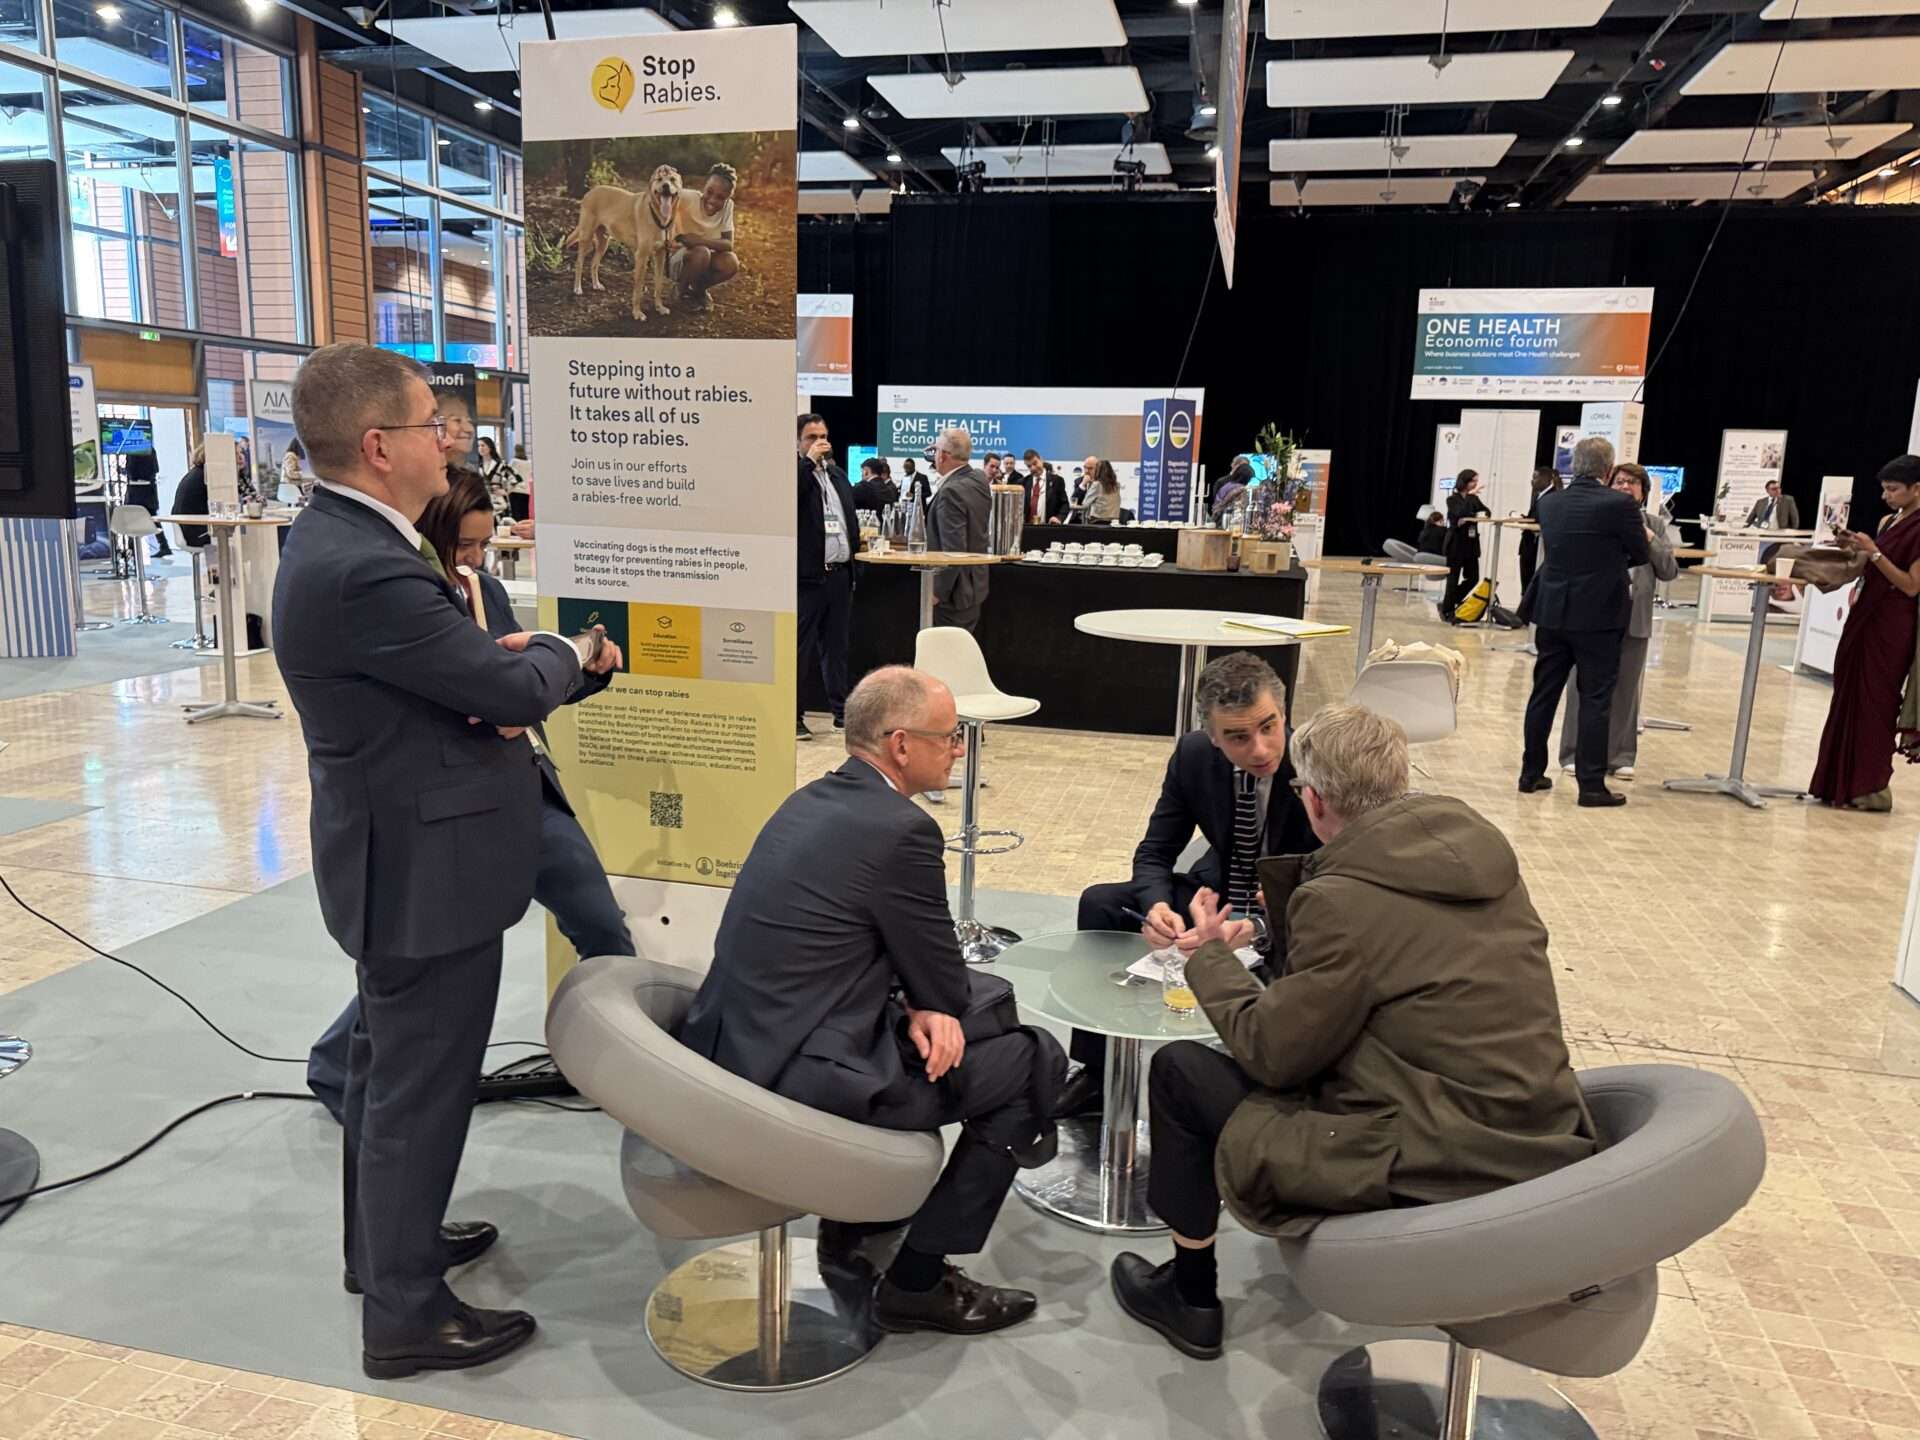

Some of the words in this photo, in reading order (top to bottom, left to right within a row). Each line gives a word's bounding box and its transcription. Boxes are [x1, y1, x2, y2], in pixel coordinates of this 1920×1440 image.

[642, 55, 695, 79] Stop
[644, 81, 720, 104] Rabies.
[1427, 319, 1471, 335] ONE
[1478, 319, 1561, 335] HEALTH
[1425, 334, 1504, 348] Economic
[1509, 334, 1558, 348] forum
[569, 360, 645, 381] Stepping
[649, 361, 681, 378] into
[686, 366, 695, 378] a
[428, 373, 464, 386] anofi
[569, 382, 620, 399] future
[624, 384, 691, 400] without
[695, 385, 752, 403] rabies.
[570, 405, 581, 420] It
[586, 405, 630, 422] takes
[634, 406, 655, 422] all
[659, 408, 676, 423] of
[681, 412, 700, 424] us
[892, 418, 928, 433] ONE
[935, 419, 1000, 434] HEALTH
[570, 428, 587, 443] to
[592, 429, 628, 447] stop
[633, 429, 689, 446] rabies.
[971, 436, 1007, 446] orum
[571, 458, 595, 470] Join
[597, 461, 610, 470] us
[614, 459, 623, 471] in
[626, 463, 645, 472] our
[648, 461, 687, 474] efforts
[572, 475, 583, 486] to
[586, 478, 611, 487] save
[614, 476, 640, 488] lives
[643, 478, 663, 490] and
[667, 478, 695, 490] build
[572, 493, 578, 502] a
[581, 491, 643, 504] rabies-free
[646, 495, 681, 506] world.
[574, 540, 624, 553] Vaccinating
[626, 543, 647, 553] dogs
[650, 544, 656, 553] is
[659, 545, 673, 554] the
[675, 546, 697, 555] most
[700, 546, 740, 557] effective
[574, 553, 609, 563] strategy
[612, 554, 624, 562] for
[626, 555, 672, 567] preventing
[675, 558, 702, 567] rabies
[704, 560, 712, 568] in
[714, 561, 748, 571] people,
[575, 565, 610, 573] because
[613, 566, 619, 574] it
[621, 567, 645, 577] stops
[646, 568, 660, 577] the
[663, 570, 719, 580] transmission
[585, 577, 595, 585] its
[598, 579, 629, 587] source.
[645, 689, 663, 698] stop
[664, 688, 690, 698] rabies
